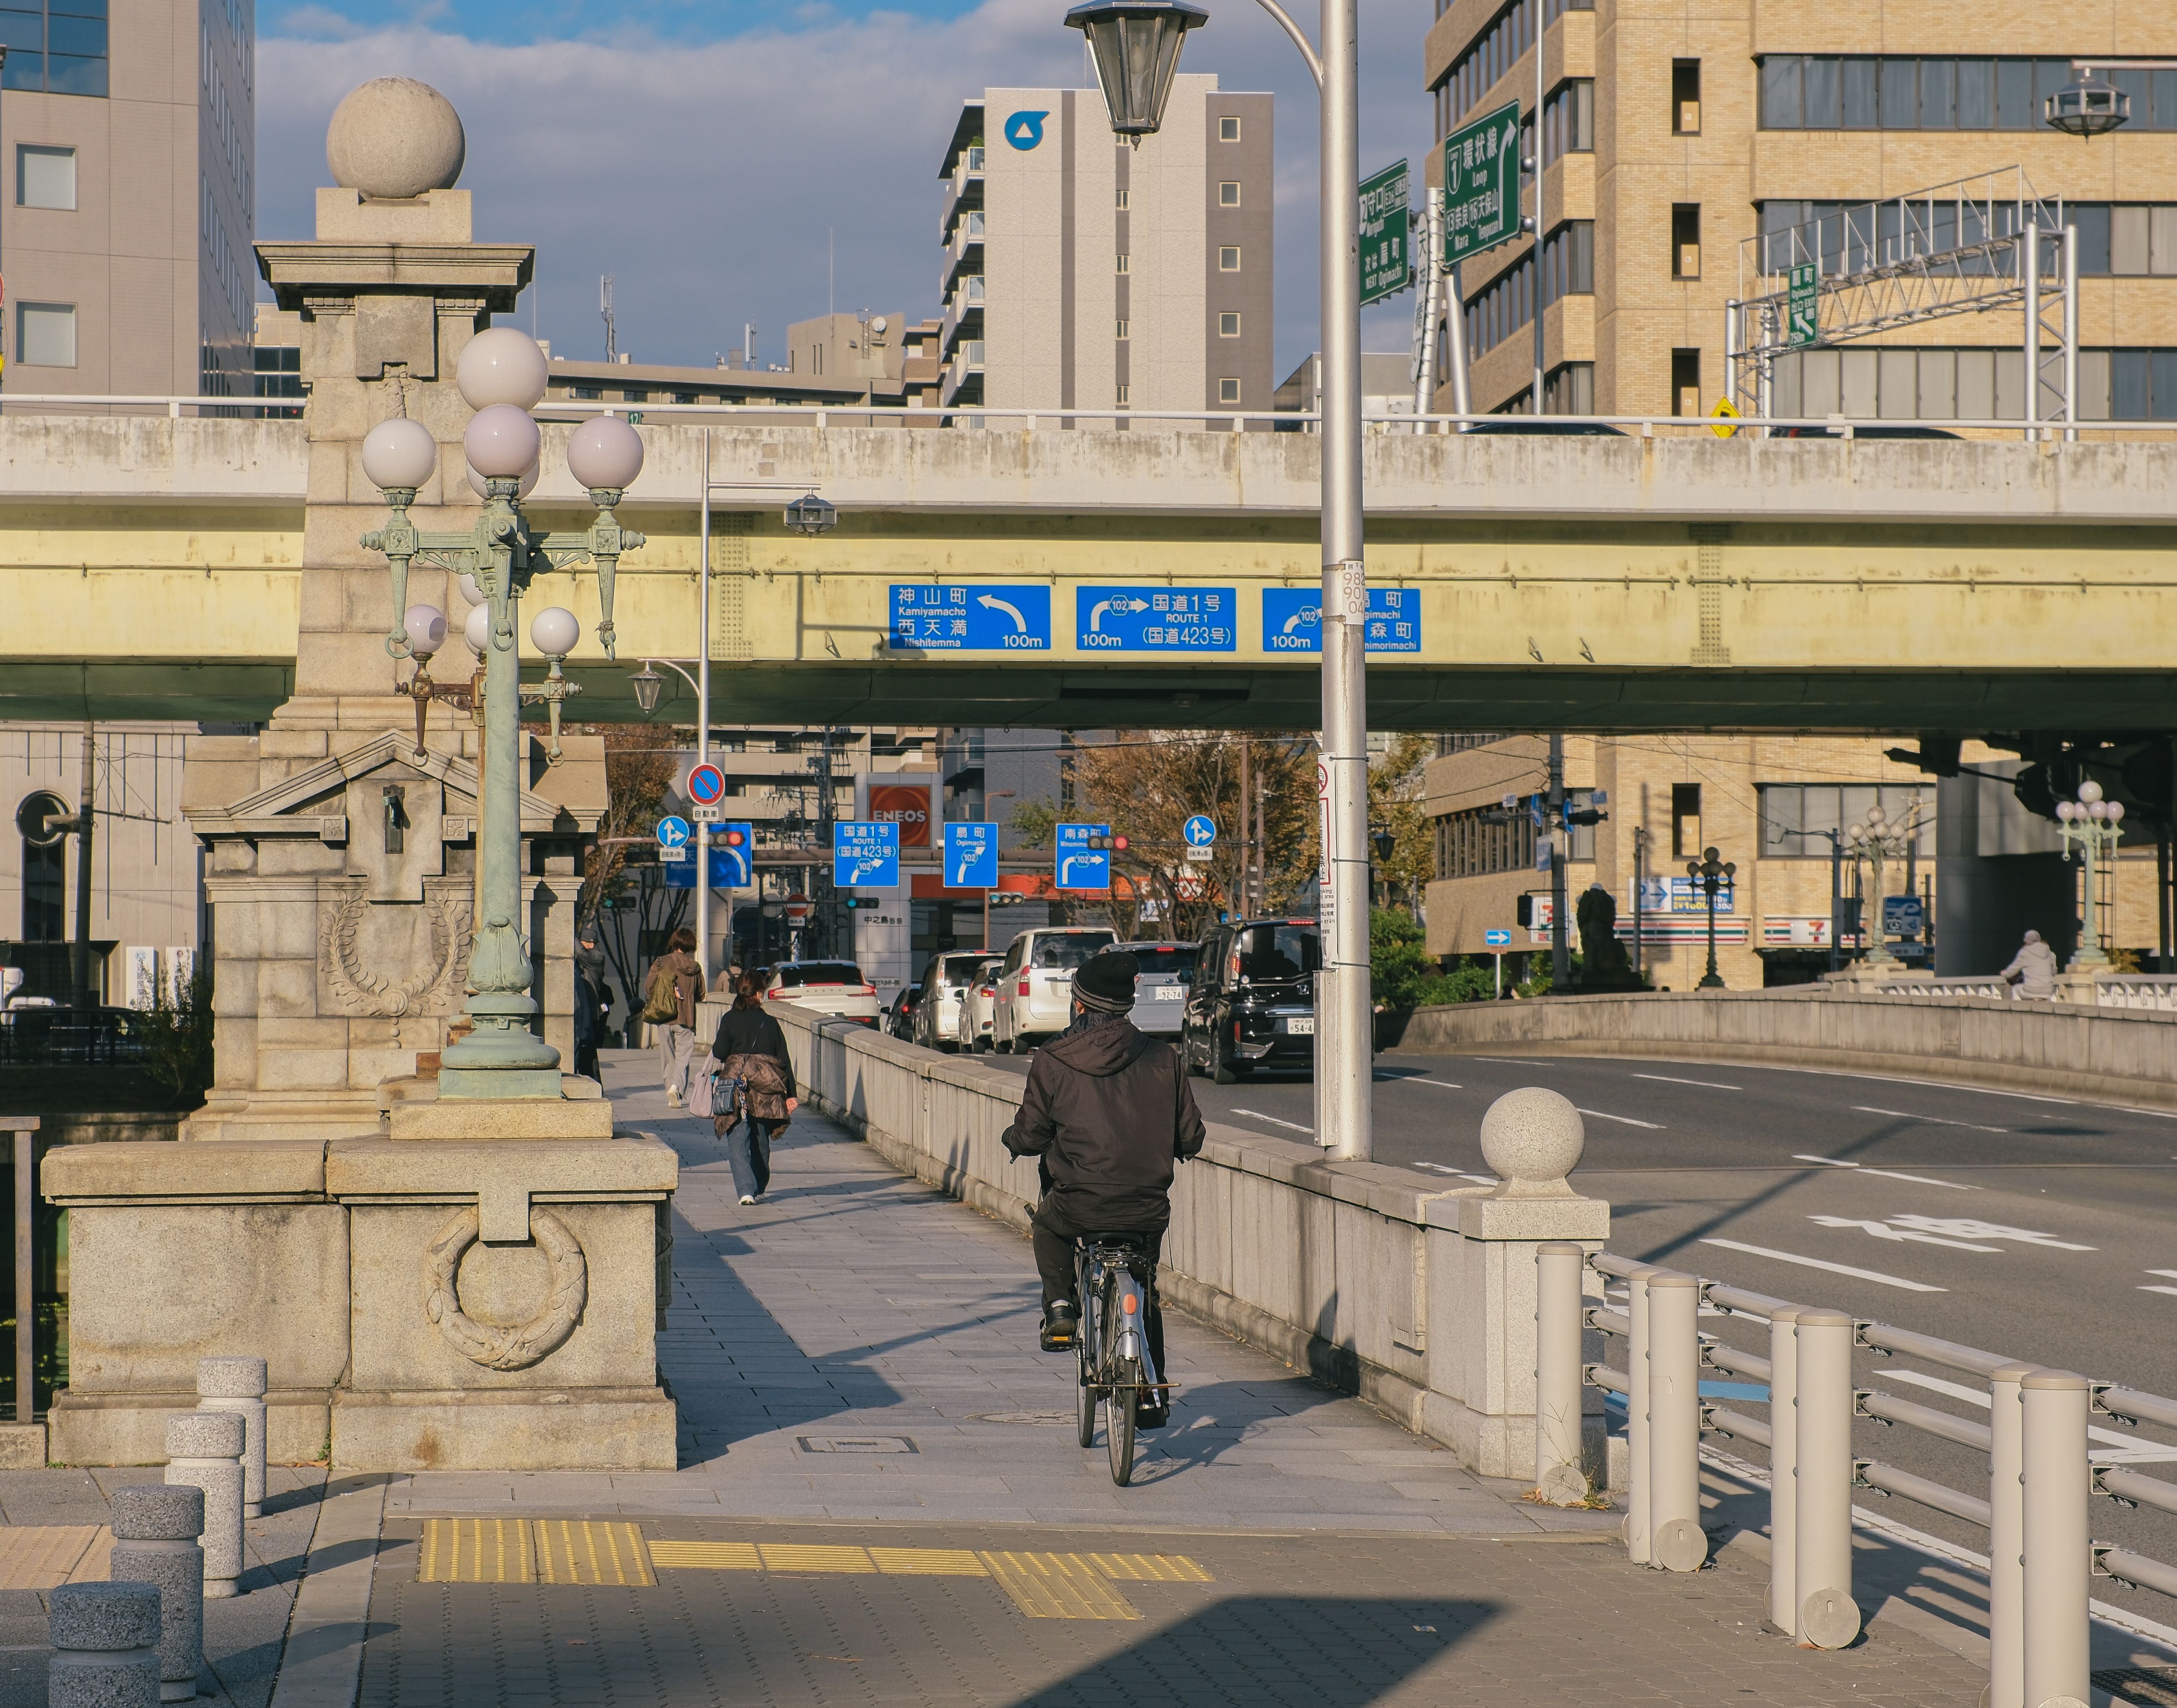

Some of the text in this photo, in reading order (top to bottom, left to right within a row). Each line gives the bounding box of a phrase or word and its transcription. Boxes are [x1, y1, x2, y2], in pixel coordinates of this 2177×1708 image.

[1463, 127, 1497, 169] 環状線
[1472, 170, 1487, 187] Loop
[1368, 187, 1384, 216] 守口
[1478, 188, 1498, 219] 天保山
[1455, 203, 1468, 229] 奈良
[1470, 201, 1477, 223] 16
[1447, 214, 1454, 232] 13
[1455, 234, 1469, 251] Nara
[1380, 237, 1400, 265] 扇町
[1366, 261, 1402, 290] NEXT Ogimachi
[898, 588, 967, 606] 神山町
[1152, 594, 1221, 612] 国道1号
[1112, 600, 1127, 611] 102
[1348, 601, 1364, 614] 04
[899, 607, 966, 618] Kamiyamacho
[1166, 614, 1208, 623] ROUTE 1
[1301, 611, 1316, 621] 102
[898, 620, 967, 636] 西天満
[1002, 635, 1042, 648] 100m
[1082, 634, 1122, 647] 100m
[1142, 627, 1231, 645] (国道423号)
[1271, 636, 1311, 648] 100m
[904, 638, 962, 648] Nishitemma
[873, 810, 927, 822] ENEOS
[844, 825, 889, 837] 国道1号
[956, 827, 986, 838] 扇町
[1065, 828, 1101, 840] 南森町
[838, 845, 896, 857] (国道423号)
[964, 854, 977, 862] 102
[1295, 1024, 1312, 1033] 54-4
